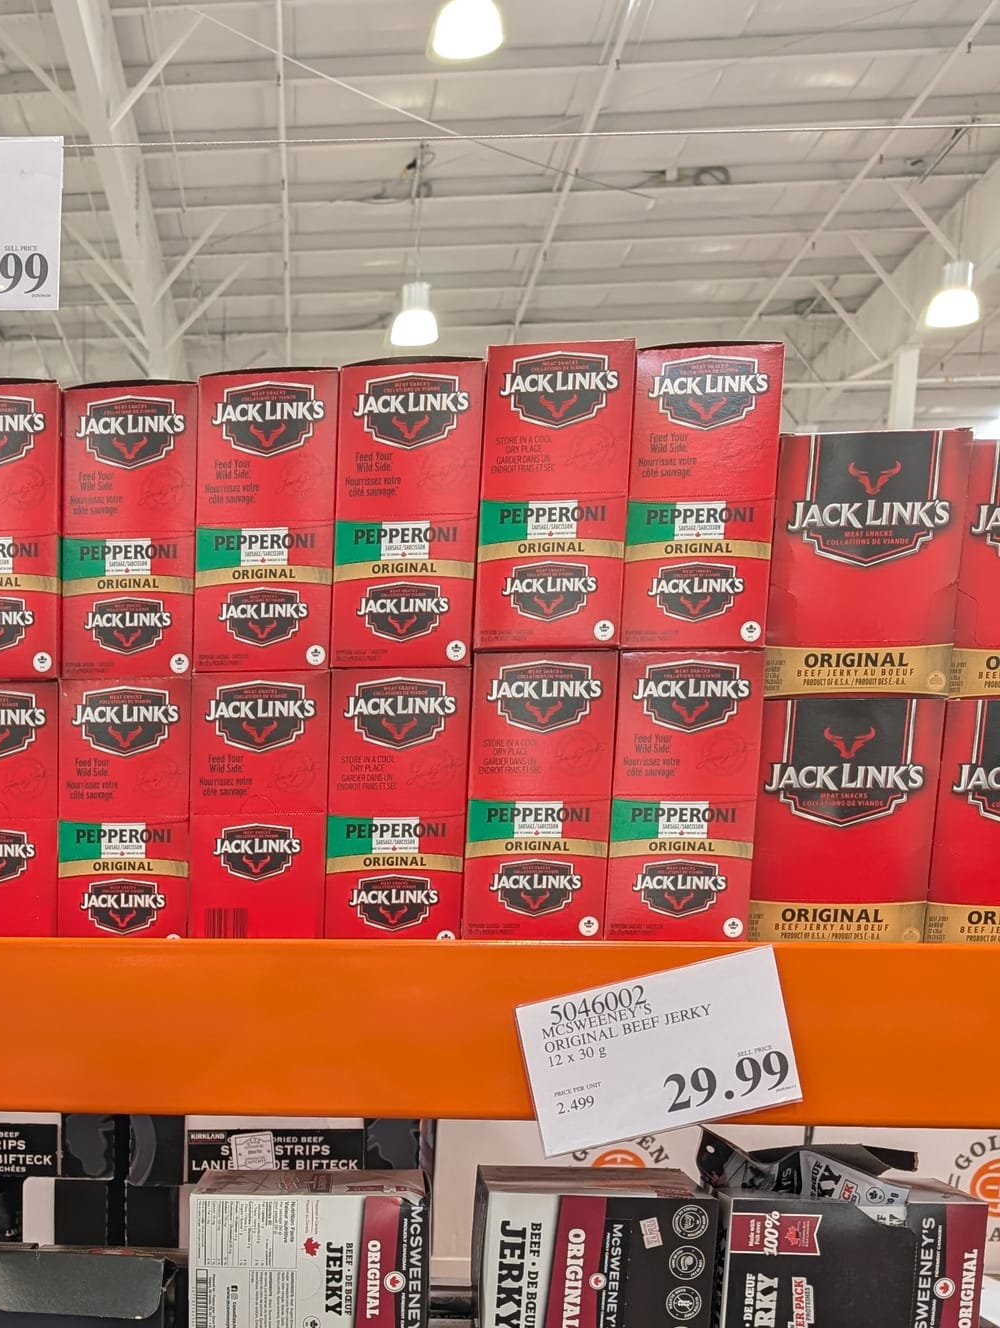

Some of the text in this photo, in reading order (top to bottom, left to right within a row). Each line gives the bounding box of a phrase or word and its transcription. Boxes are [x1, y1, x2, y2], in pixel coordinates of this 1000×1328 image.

[650, 433, 688, 442] Feed Your
[650, 443, 668, 452] Wild
[788, 499, 950, 533] JACK LINK'S
[826, 538, 868, 546] COLLATIONS
[803, 652, 909, 668] ORIGINAL
[797, 667, 915, 677] BEEF JERKY AU BOEUF
[550, 985, 647, 1025] 5046002
[542, 1003, 652, 1039] MCSWEENEY'S
[544, 1004, 711, 1053] ORIGINAL BEEF JERKY
[549, 1047, 607, 1067] 12 x 30 g
[737, 1045, 772, 1057] SELL PRICE
[554, 1089, 572, 1097] PRICE
[586, 1082, 601, 1091] UNIT
[663, 1050, 789, 1113] 29.99
[557, 1096, 595, 1115] 2.499
